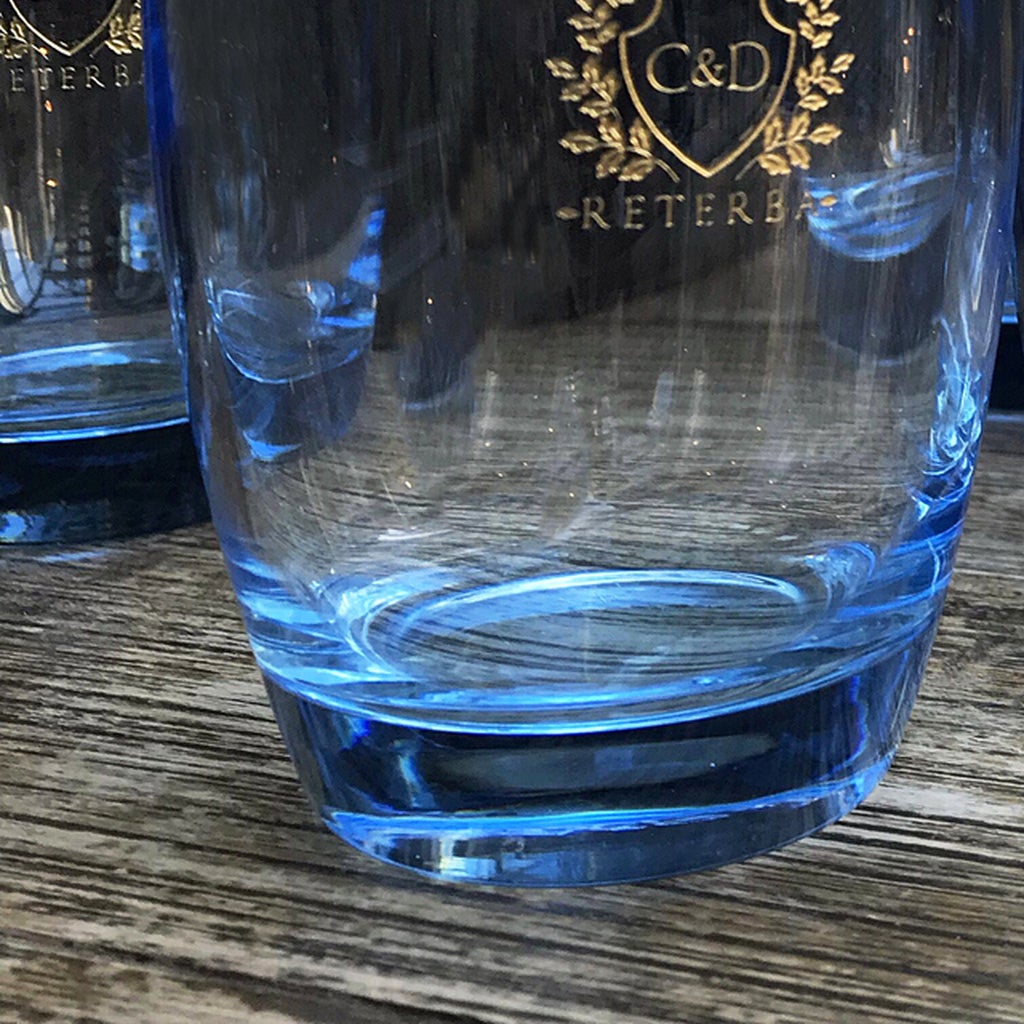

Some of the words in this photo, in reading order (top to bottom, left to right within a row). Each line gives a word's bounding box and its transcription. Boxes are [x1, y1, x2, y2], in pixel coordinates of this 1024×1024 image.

[10, 61, 143, 93] ETERB
[646, 41, 772, 95] C&D
[581, 186, 819, 231] RETERBA
